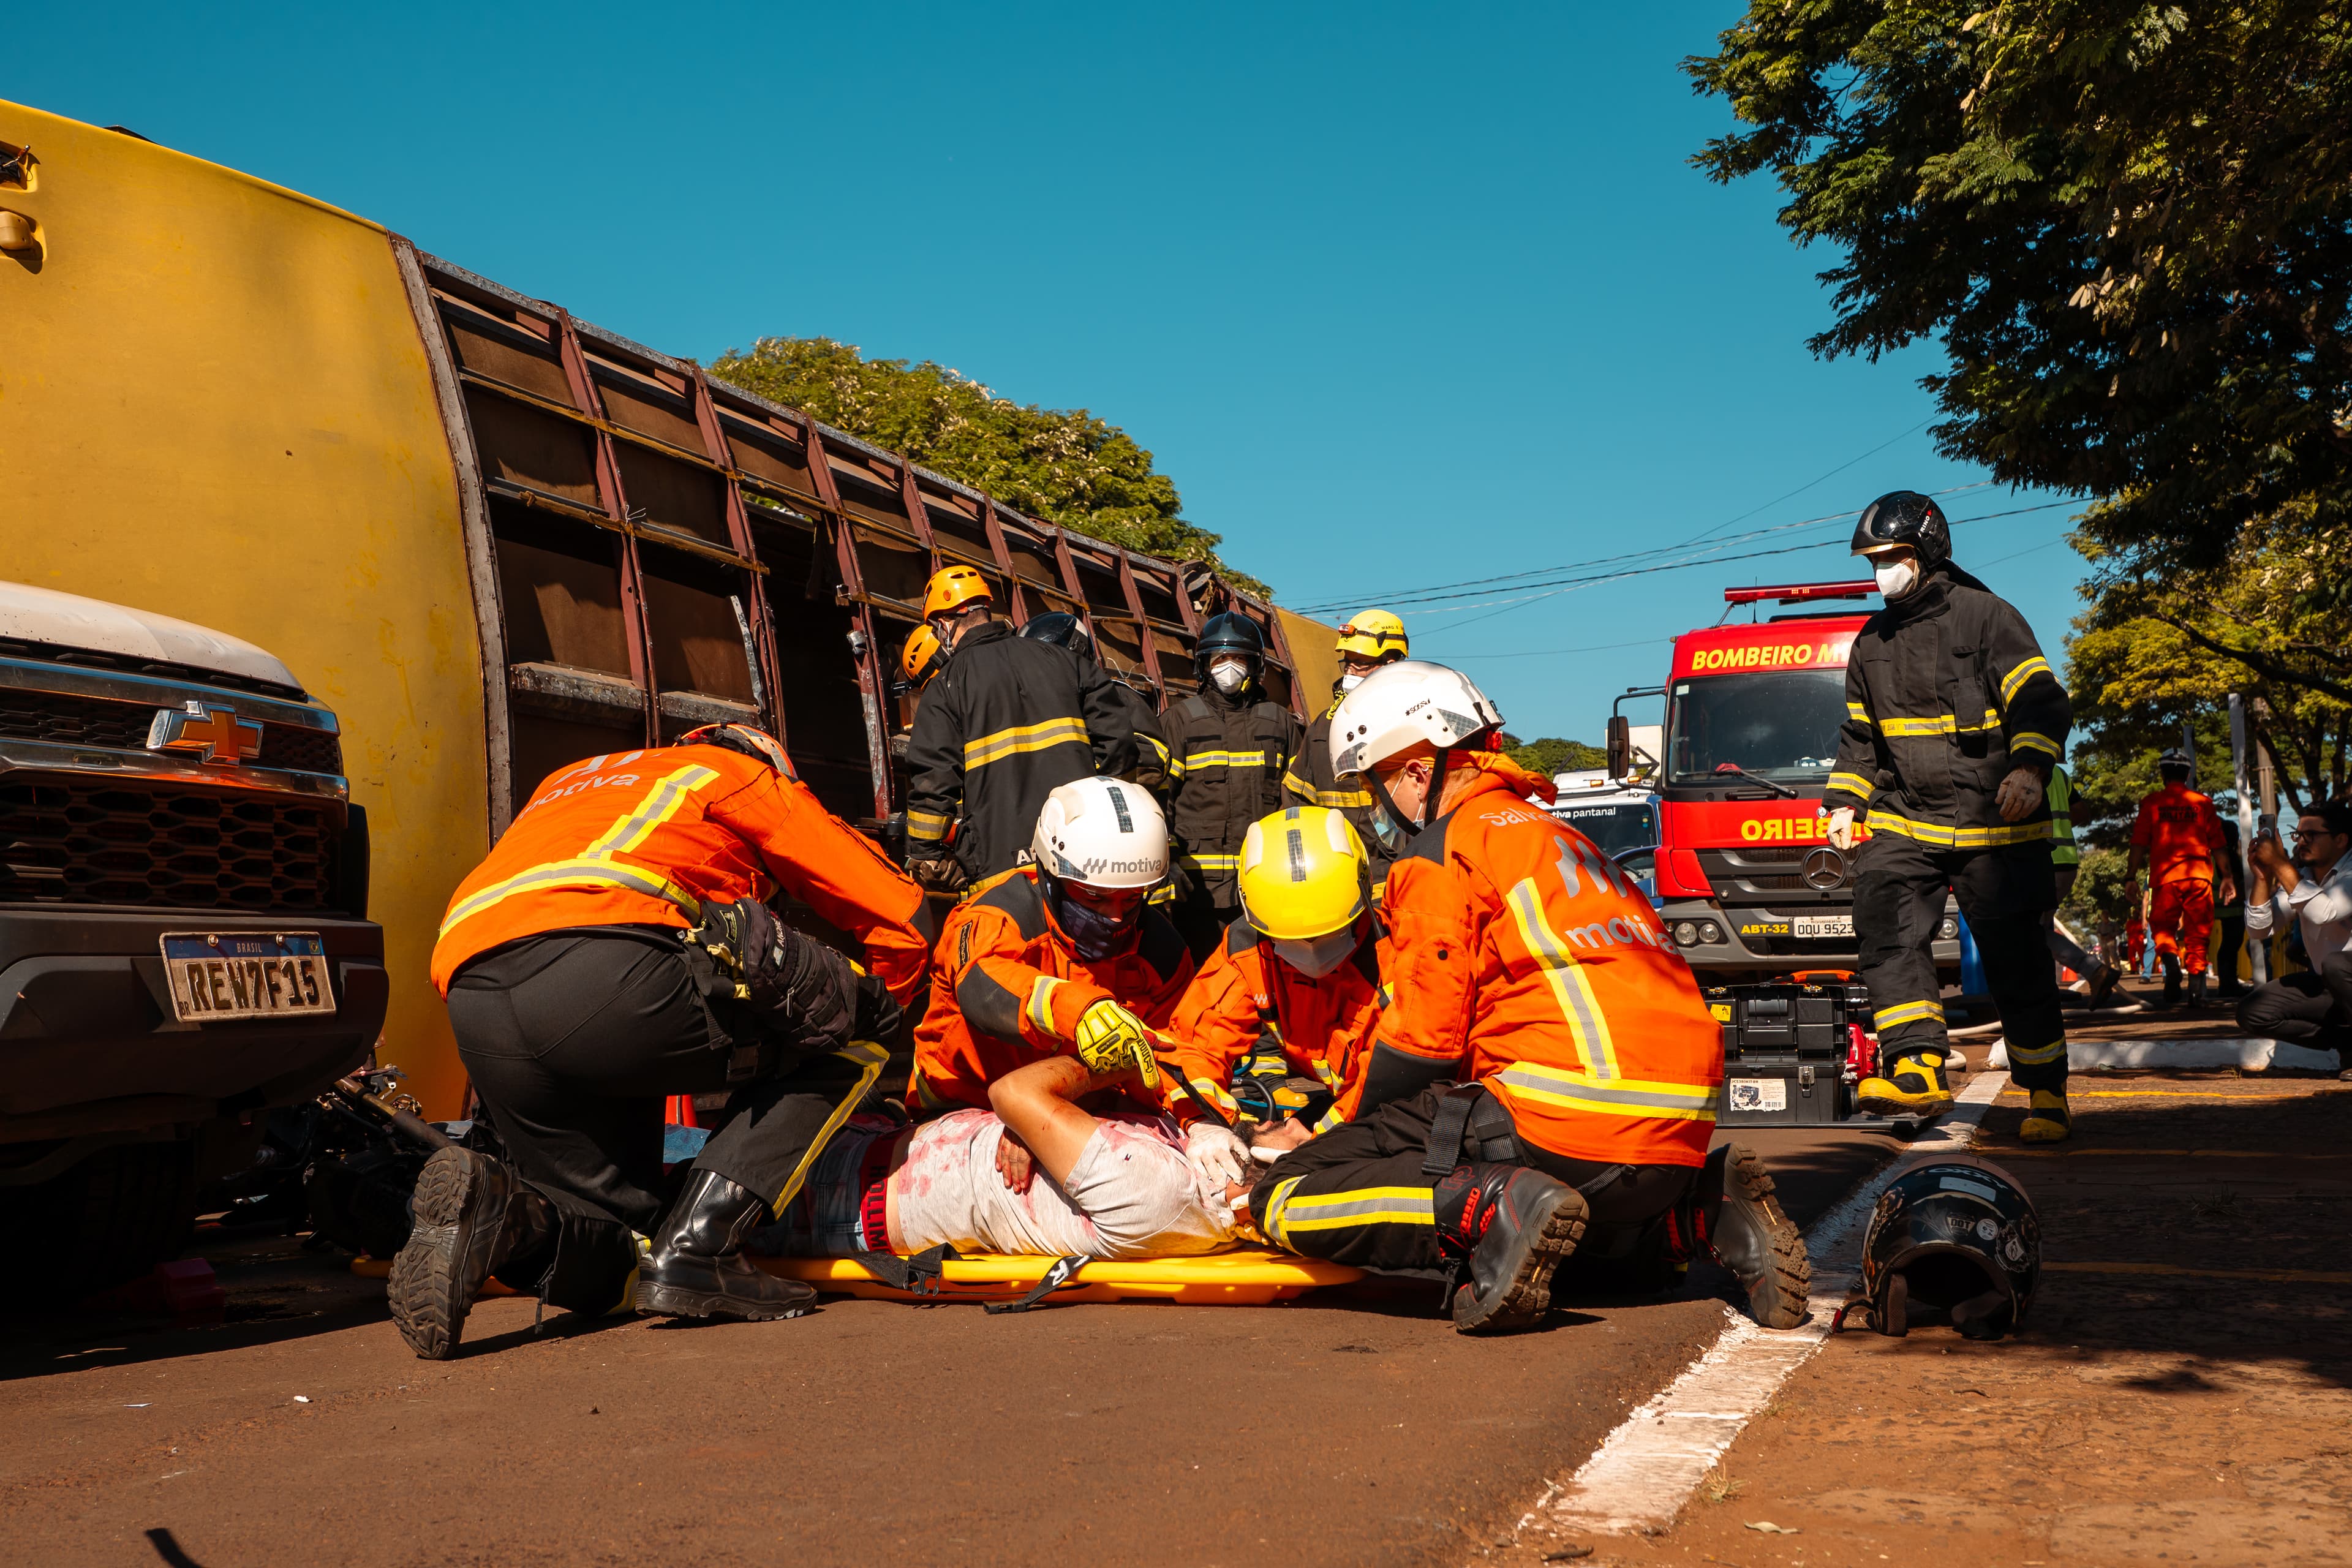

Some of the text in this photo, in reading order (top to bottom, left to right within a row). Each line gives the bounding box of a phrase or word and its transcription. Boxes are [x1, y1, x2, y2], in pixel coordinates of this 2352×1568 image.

[1692, 643, 1849, 670] BOMBEIRO MI
[1573, 807, 1616, 820] pantanal
[1111, 858, 1162, 873] motiva
[1741, 924, 1789, 934] ABT-32
[236, 943, 263, 954] BRASIL
[184, 959, 320, 1011] REW7F15
[178, 1001, 191, 1016] BR
[1950, 1218, 1970, 1229] DOT
